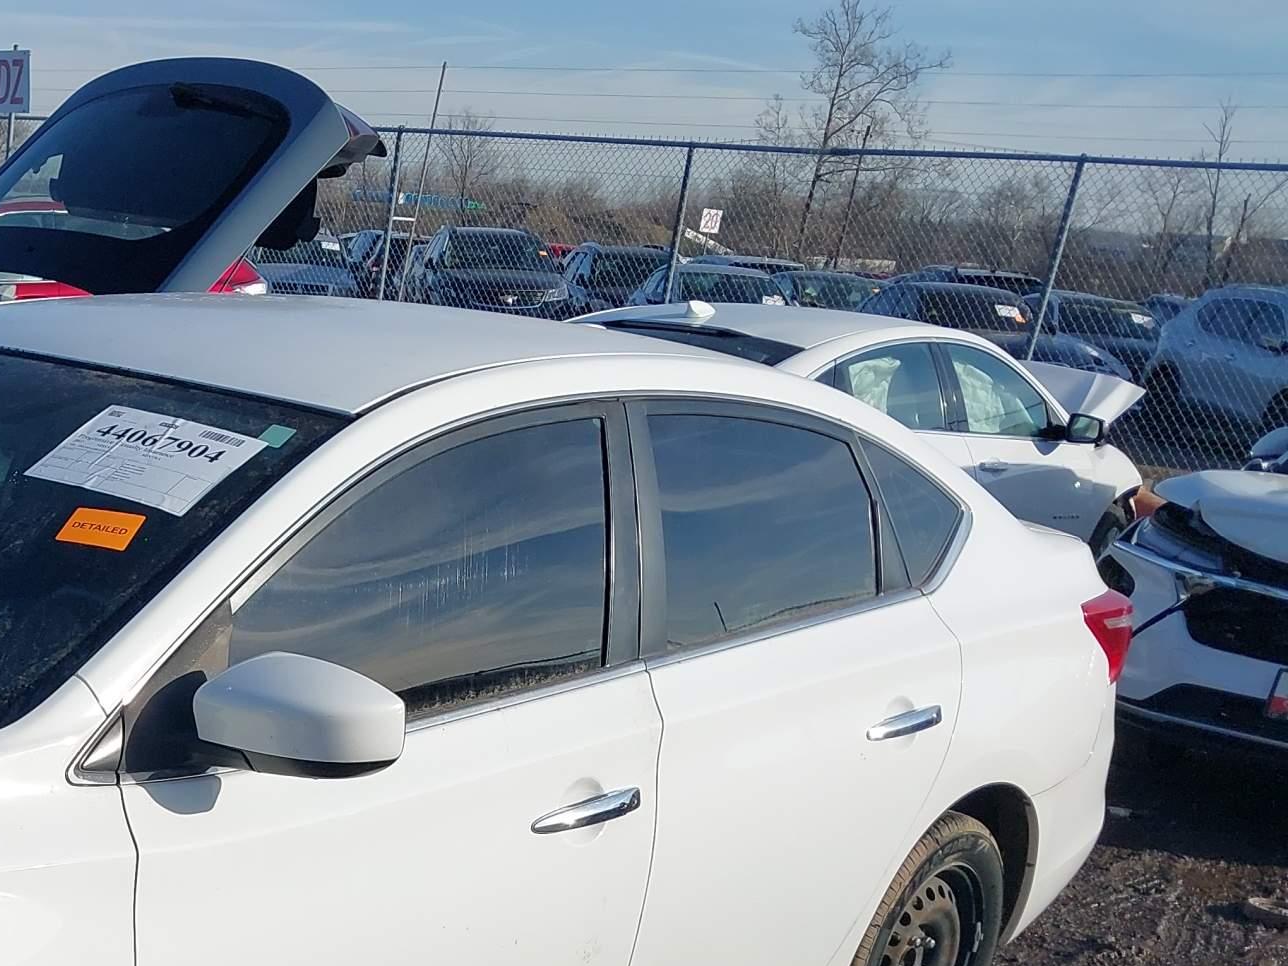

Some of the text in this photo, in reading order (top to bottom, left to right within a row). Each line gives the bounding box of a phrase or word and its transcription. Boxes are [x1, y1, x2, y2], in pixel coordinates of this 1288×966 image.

[703, 211, 721, 229] 20
[97, 424, 227, 463] 44067904
[72, 521, 128, 535] DETAILED
